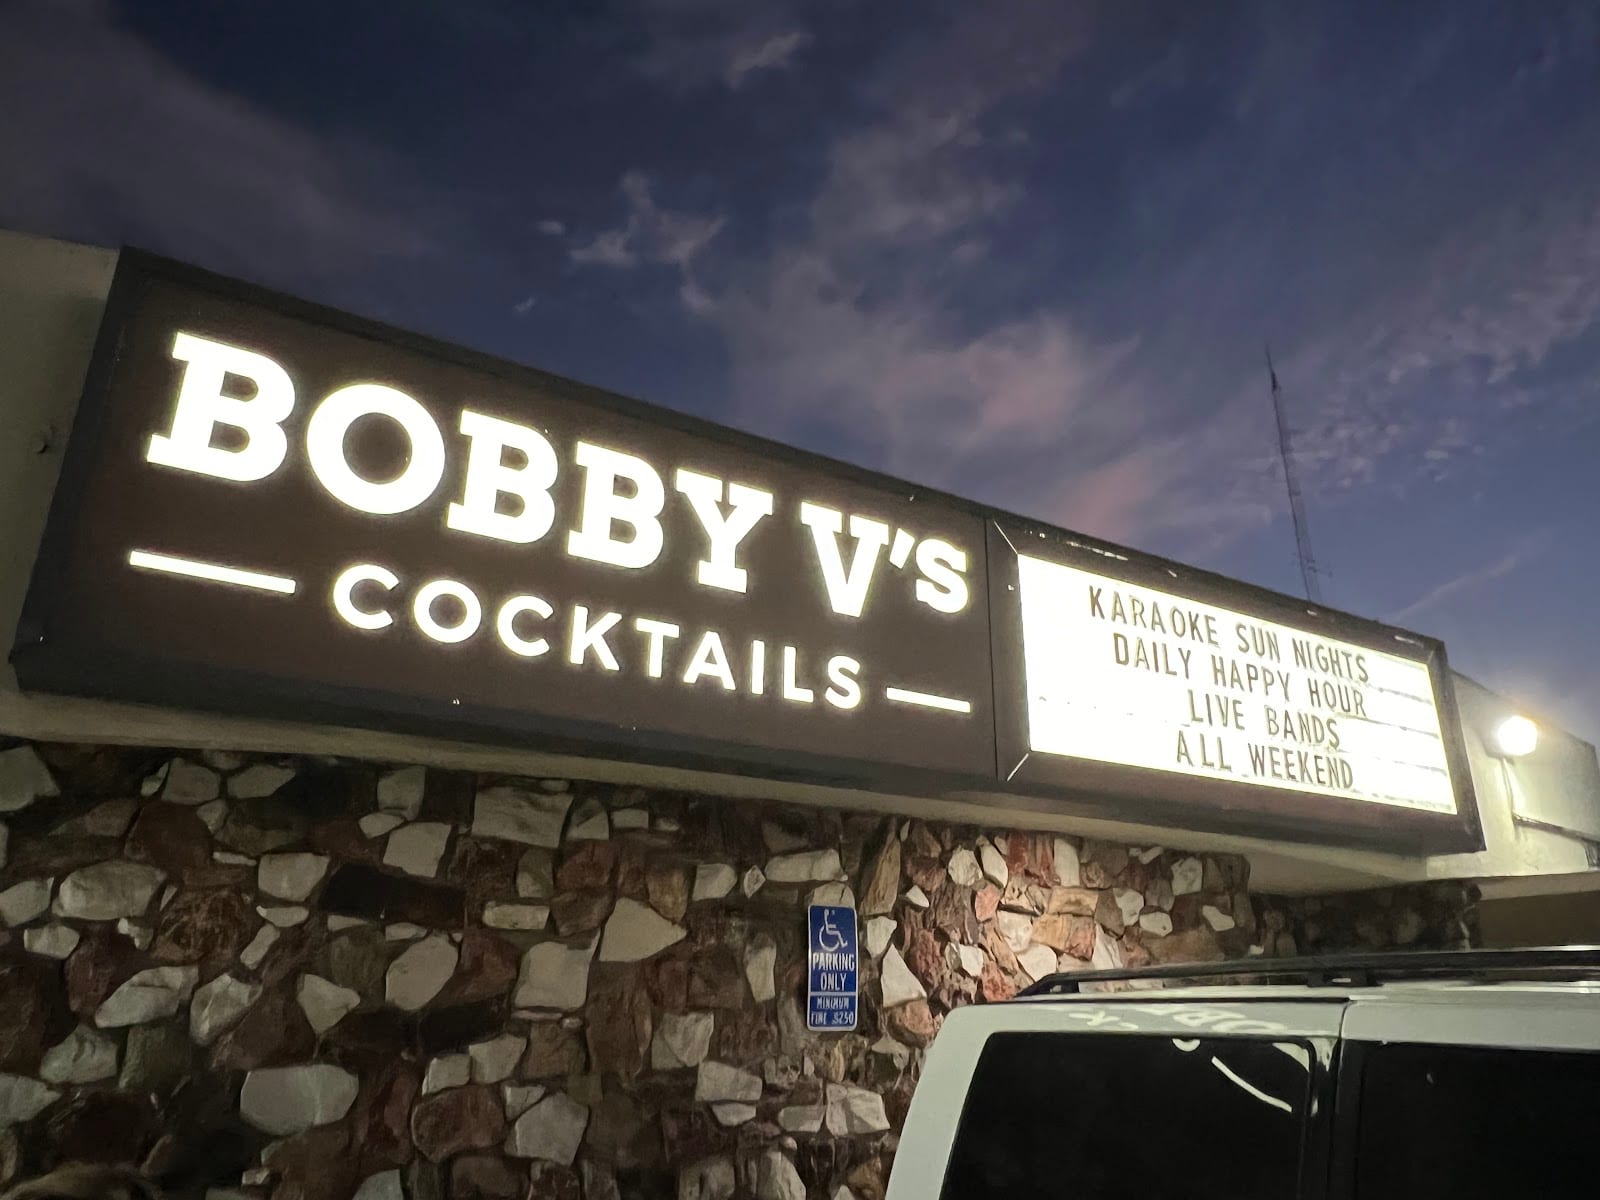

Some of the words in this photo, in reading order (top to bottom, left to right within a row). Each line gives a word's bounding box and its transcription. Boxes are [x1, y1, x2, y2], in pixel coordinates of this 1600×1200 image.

[146, 331, 774, 594] BOBBY
[799, 501, 971, 618] V'S
[333, 563, 862, 710] COCKTAILS
[1089, 585, 1218, 646] KARAOKE
[1235, 623, 1281, 662] SUN
[1292, 638, 1369, 683] NIGHTS
[1113, 633, 1191, 679] DAILY
[1211, 654, 1291, 701] HAPPY
[1307, 677, 1366, 717] HOUR
[1187, 688, 1245, 730] LIVE
[1265, 704, 1340, 749] BANDS
[1176, 730, 1232, 771] ALL
[1248, 742, 1354, 790] WEEKEND
[812, 952, 855, 971] PARKING
[820, 972, 847, 991] ONLY
[817, 996, 849, 1009] MINIMUM
